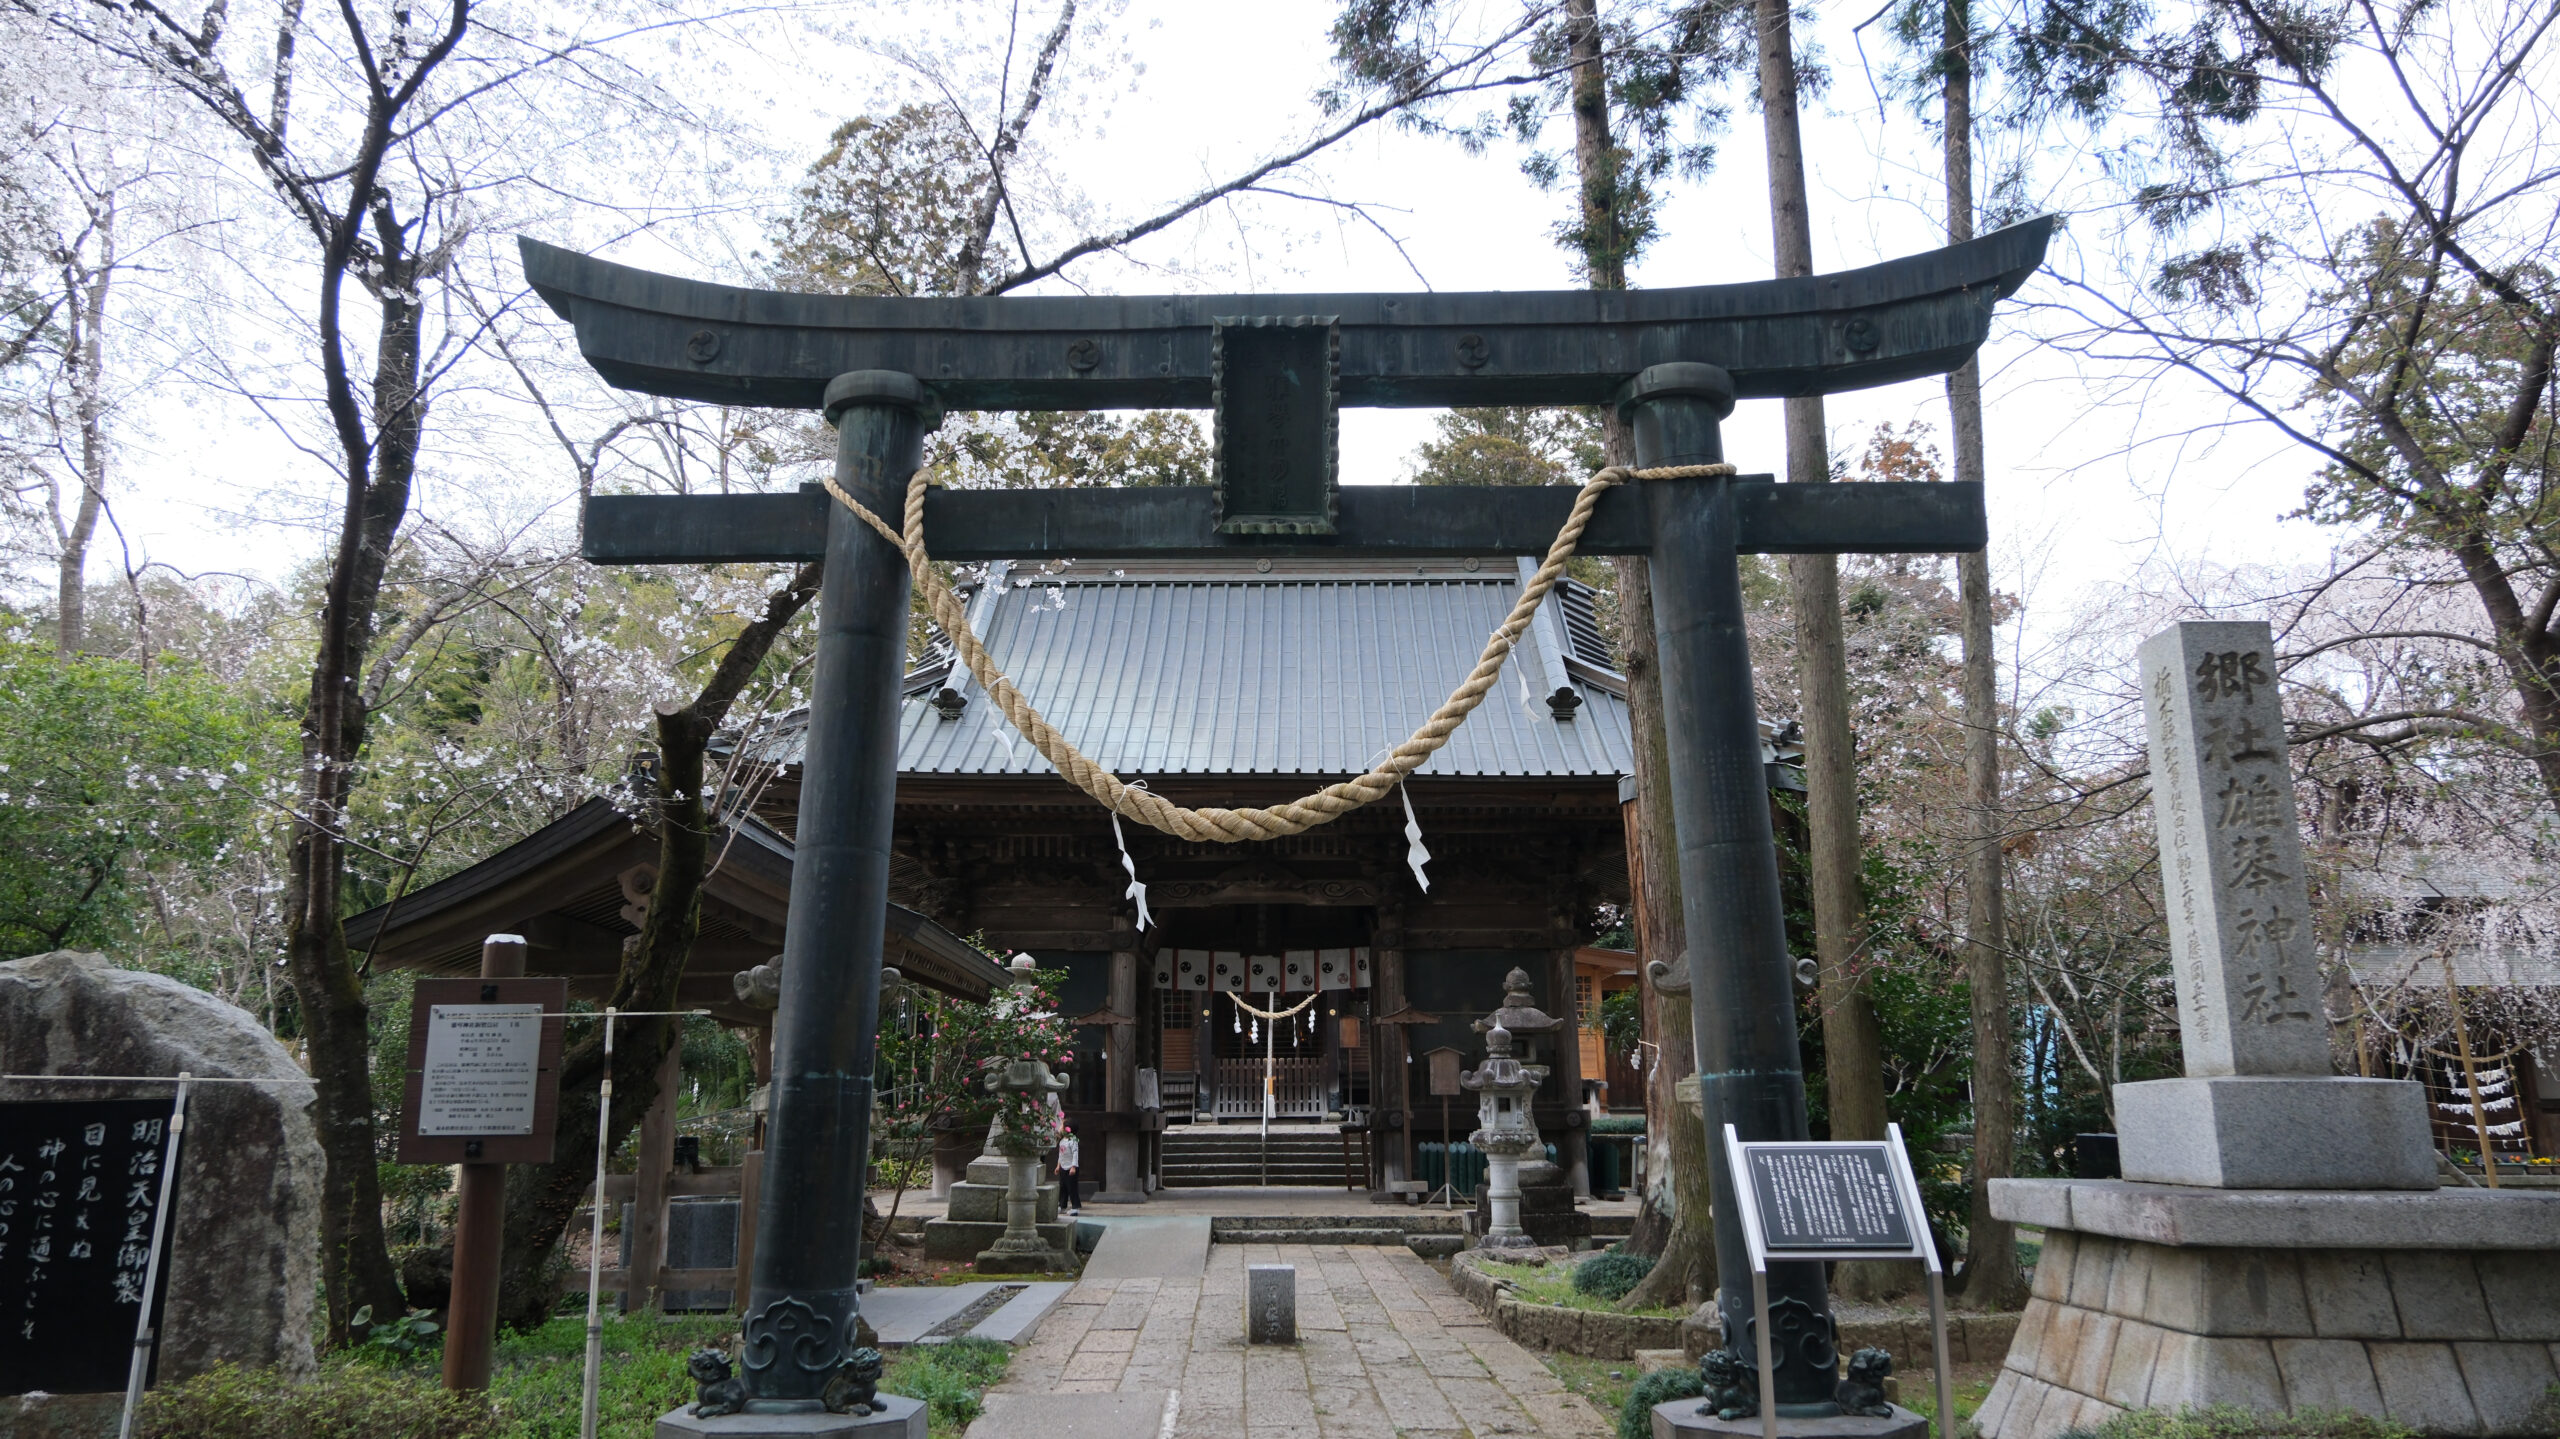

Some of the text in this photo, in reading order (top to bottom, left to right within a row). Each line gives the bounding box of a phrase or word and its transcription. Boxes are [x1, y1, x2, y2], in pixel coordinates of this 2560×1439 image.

[2195, 650, 2311, 1026] 郷社雄琴神社
[112, 1118, 164, 1303] 明治天皇御製
